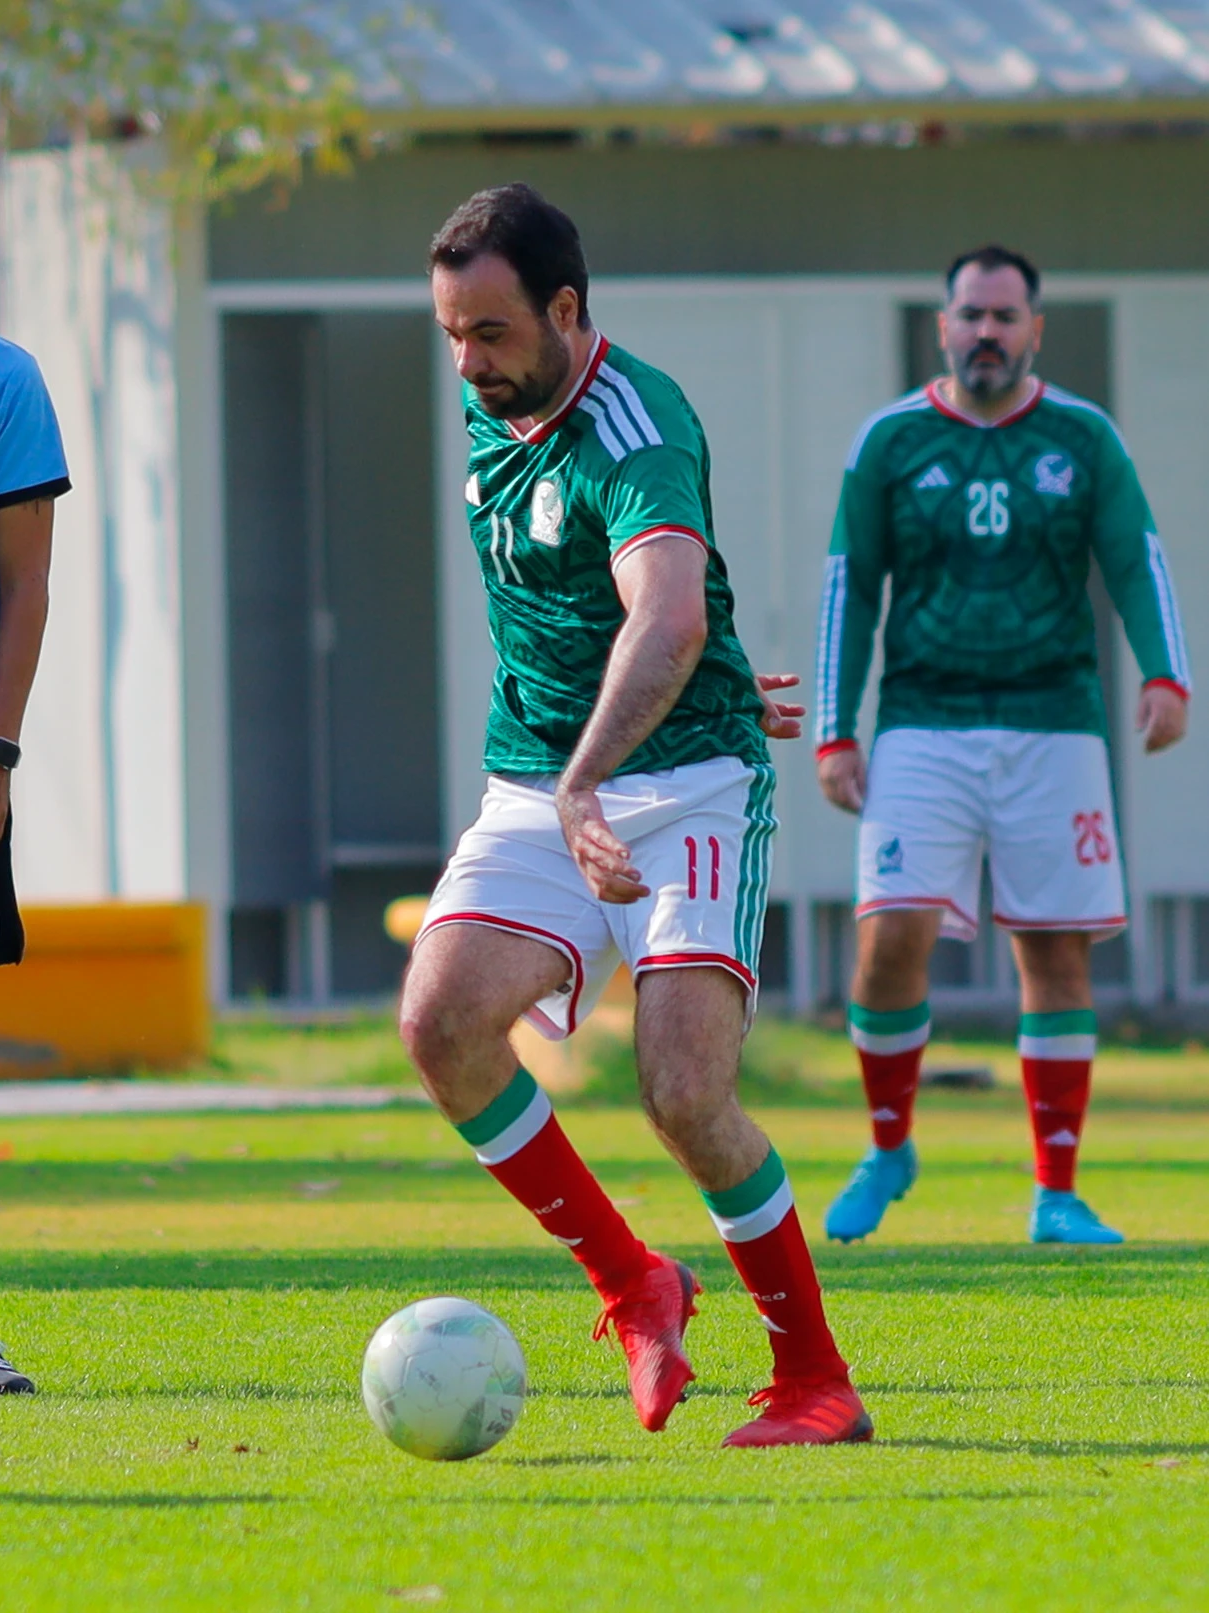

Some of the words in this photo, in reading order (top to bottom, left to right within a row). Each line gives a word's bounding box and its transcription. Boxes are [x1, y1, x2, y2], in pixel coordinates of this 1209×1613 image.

[967, 482, 1010, 535] 26
[490, 511, 525, 585] 11
[684, 835, 720, 901] 11
[1072, 811, 1112, 866] 26
